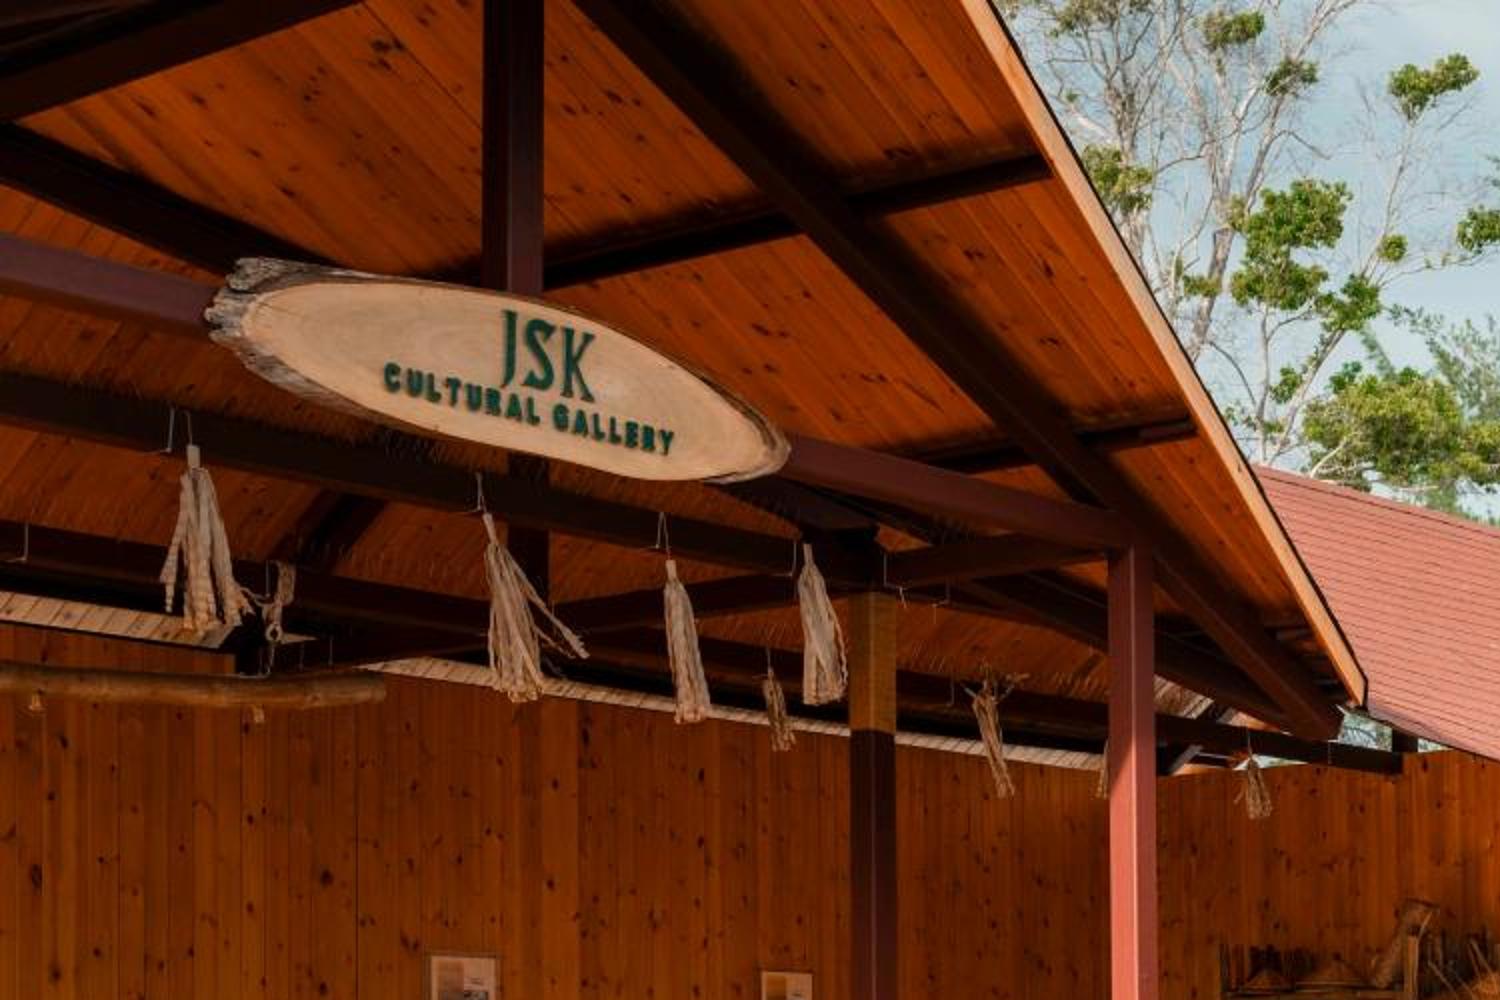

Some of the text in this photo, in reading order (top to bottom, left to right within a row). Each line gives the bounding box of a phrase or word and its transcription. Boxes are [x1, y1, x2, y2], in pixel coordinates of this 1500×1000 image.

[501, 310, 595, 402] JSK
[384, 363, 674, 456] CULTURAL GALLERY
